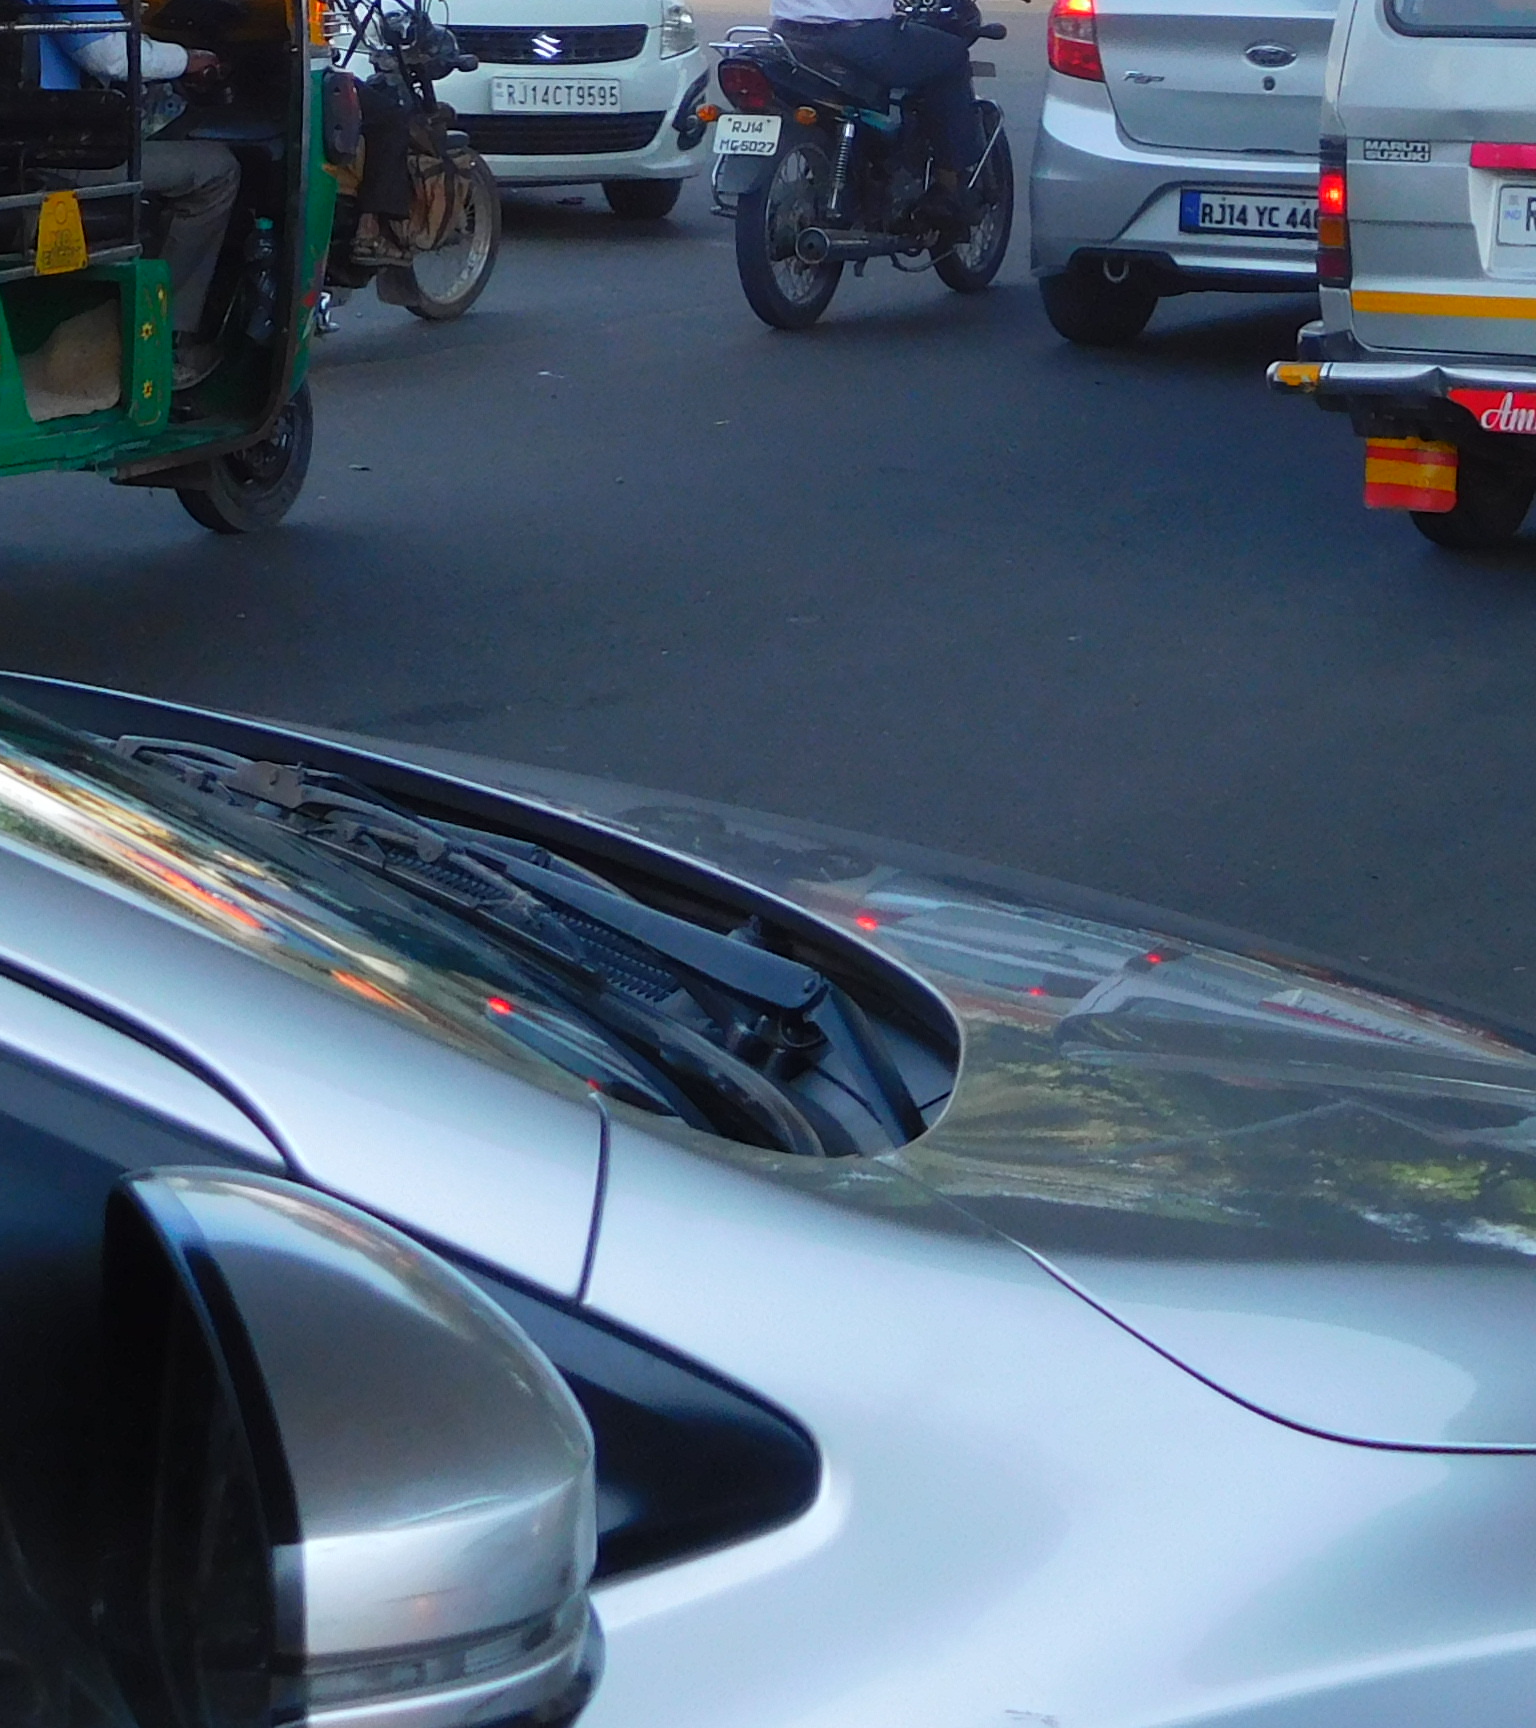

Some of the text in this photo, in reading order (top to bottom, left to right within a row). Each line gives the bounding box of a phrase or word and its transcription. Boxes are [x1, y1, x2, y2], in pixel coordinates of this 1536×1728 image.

[507, 82, 619, 106] RJ14CT9595
[731, 121, 763, 133] RJ14
[1365, 140, 1429, 152] MARUTI
[1365, 151, 1429, 161] SUZUKI
[1201, 203, 1248, 226] RJ14
[1256, 206, 1280, 228] YC
